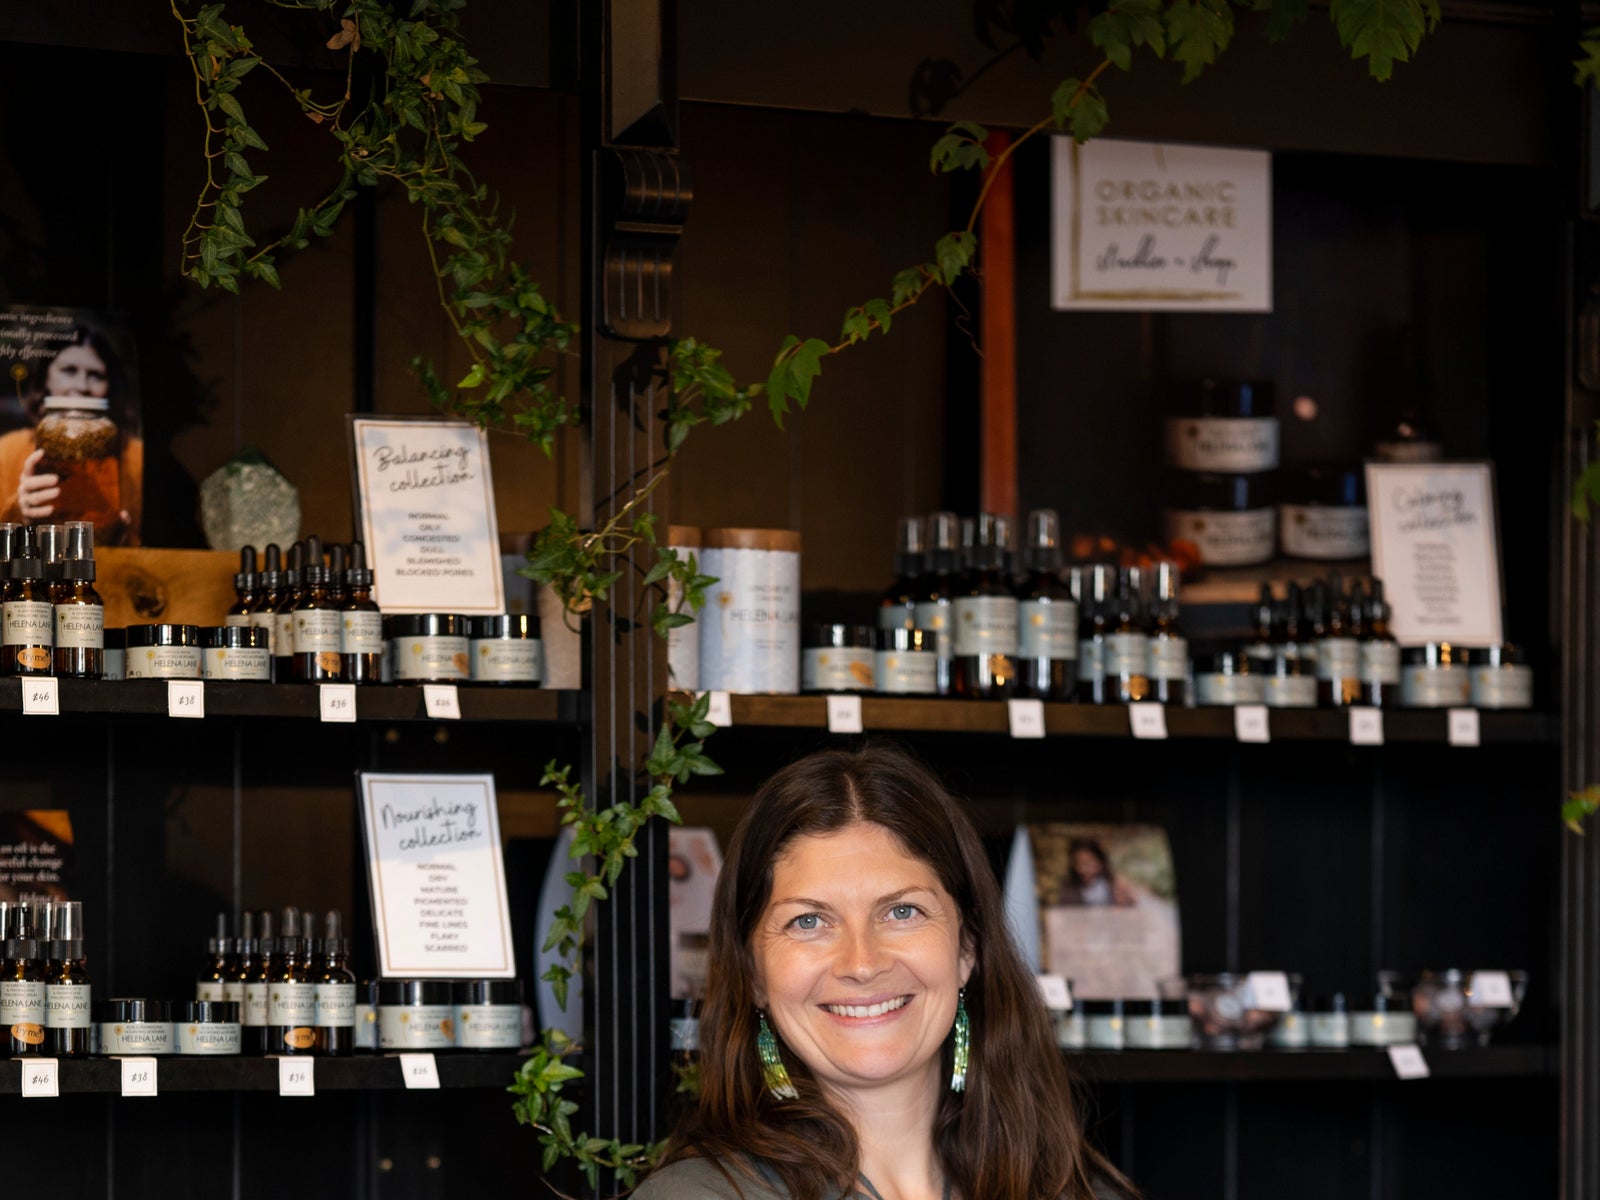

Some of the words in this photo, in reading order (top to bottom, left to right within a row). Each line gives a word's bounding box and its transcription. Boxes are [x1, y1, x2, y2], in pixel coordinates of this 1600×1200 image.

[1094, 180, 1237, 203] ORGANIC
[1096, 205, 1238, 228] SKINCARE
[373, 443, 469, 472] Balancing
[390, 463, 475, 492] collection
[10, 620, 38, 629] HELENA
[154, 659, 182, 668] HELENA
[224, 660, 251, 668] HELENA
[381, 796, 477, 829] Nourishing
[399, 819, 482, 851] collection
[72, 1002, 88, 1010] LANE
[122, 1034, 152, 1043] HELENA
[152, 1034, 167, 1043] LANE
[196, 1035, 225, 1043] HELENA
